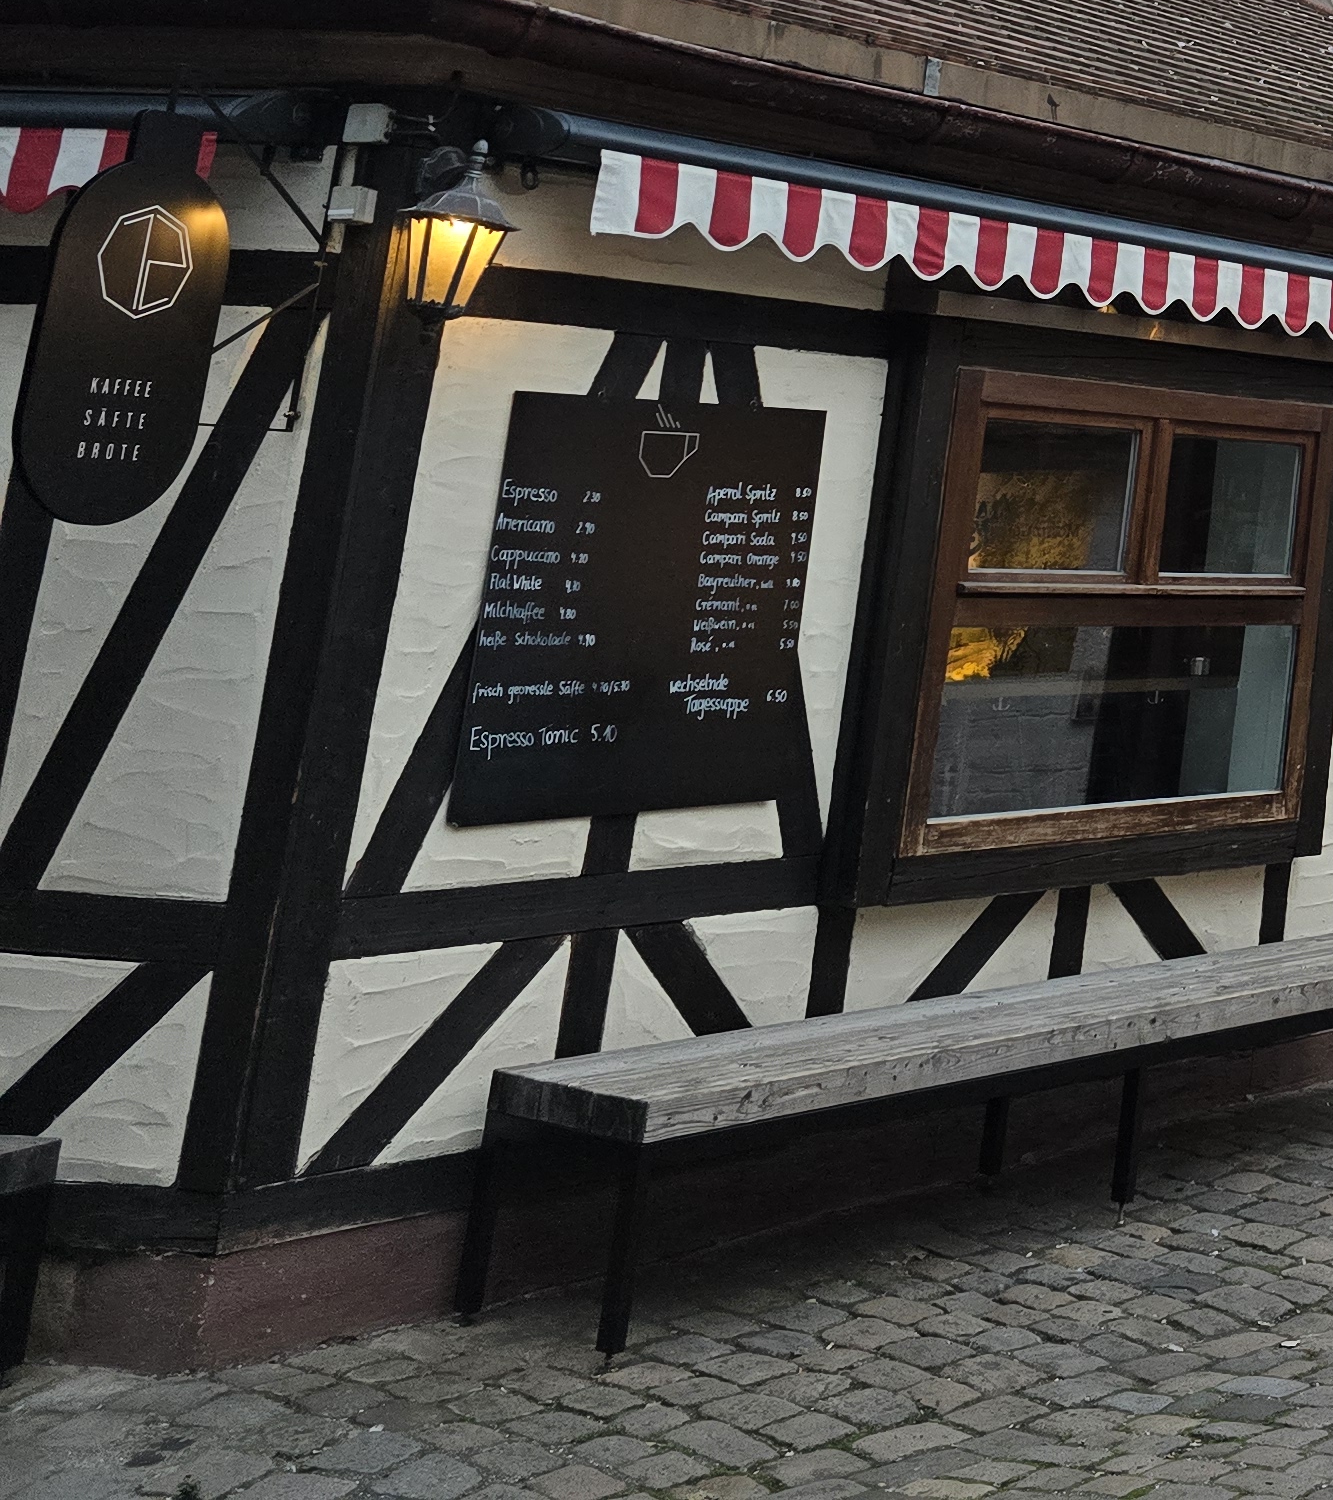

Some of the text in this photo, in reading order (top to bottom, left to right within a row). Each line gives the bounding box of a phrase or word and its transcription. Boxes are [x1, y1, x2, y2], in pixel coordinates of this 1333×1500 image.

[90, 377, 152, 398] KAFFEE
[83, 407, 147, 430] SÄFTE
[77, 441, 141, 461] BROTE
[502, 479, 558, 506] Espresso
[706, 482, 743, 506] Aperol
[745, 484, 777, 504] Spritz
[495, 512, 555, 534] Americano
[705, 509, 748, 528] Campari
[751, 508, 781, 528] Spritz
[702, 531, 746, 549] Campari
[750, 532, 775, 546] Soda
[490, 545, 561, 570] Cappuccino
[699, 551, 742, 569] Campari
[746, 552, 780, 570] Orange
[489, 573, 511, 590] Flat
[513, 574, 543, 591] White
[483, 601, 545, 624] Milchkaffee
[479, 629, 507, 651] heiße
[514, 631, 572, 648] Schokolade
[472, 682, 504, 704] frisch
[507, 680, 554, 705] gepresste
[558, 679, 586, 699] Säfte
[669, 673, 788, 703] wechselnde 6.50
[683, 693, 750, 721] Tagessuppe
[469, 723, 618, 761] Espresso Tonic 5.10
